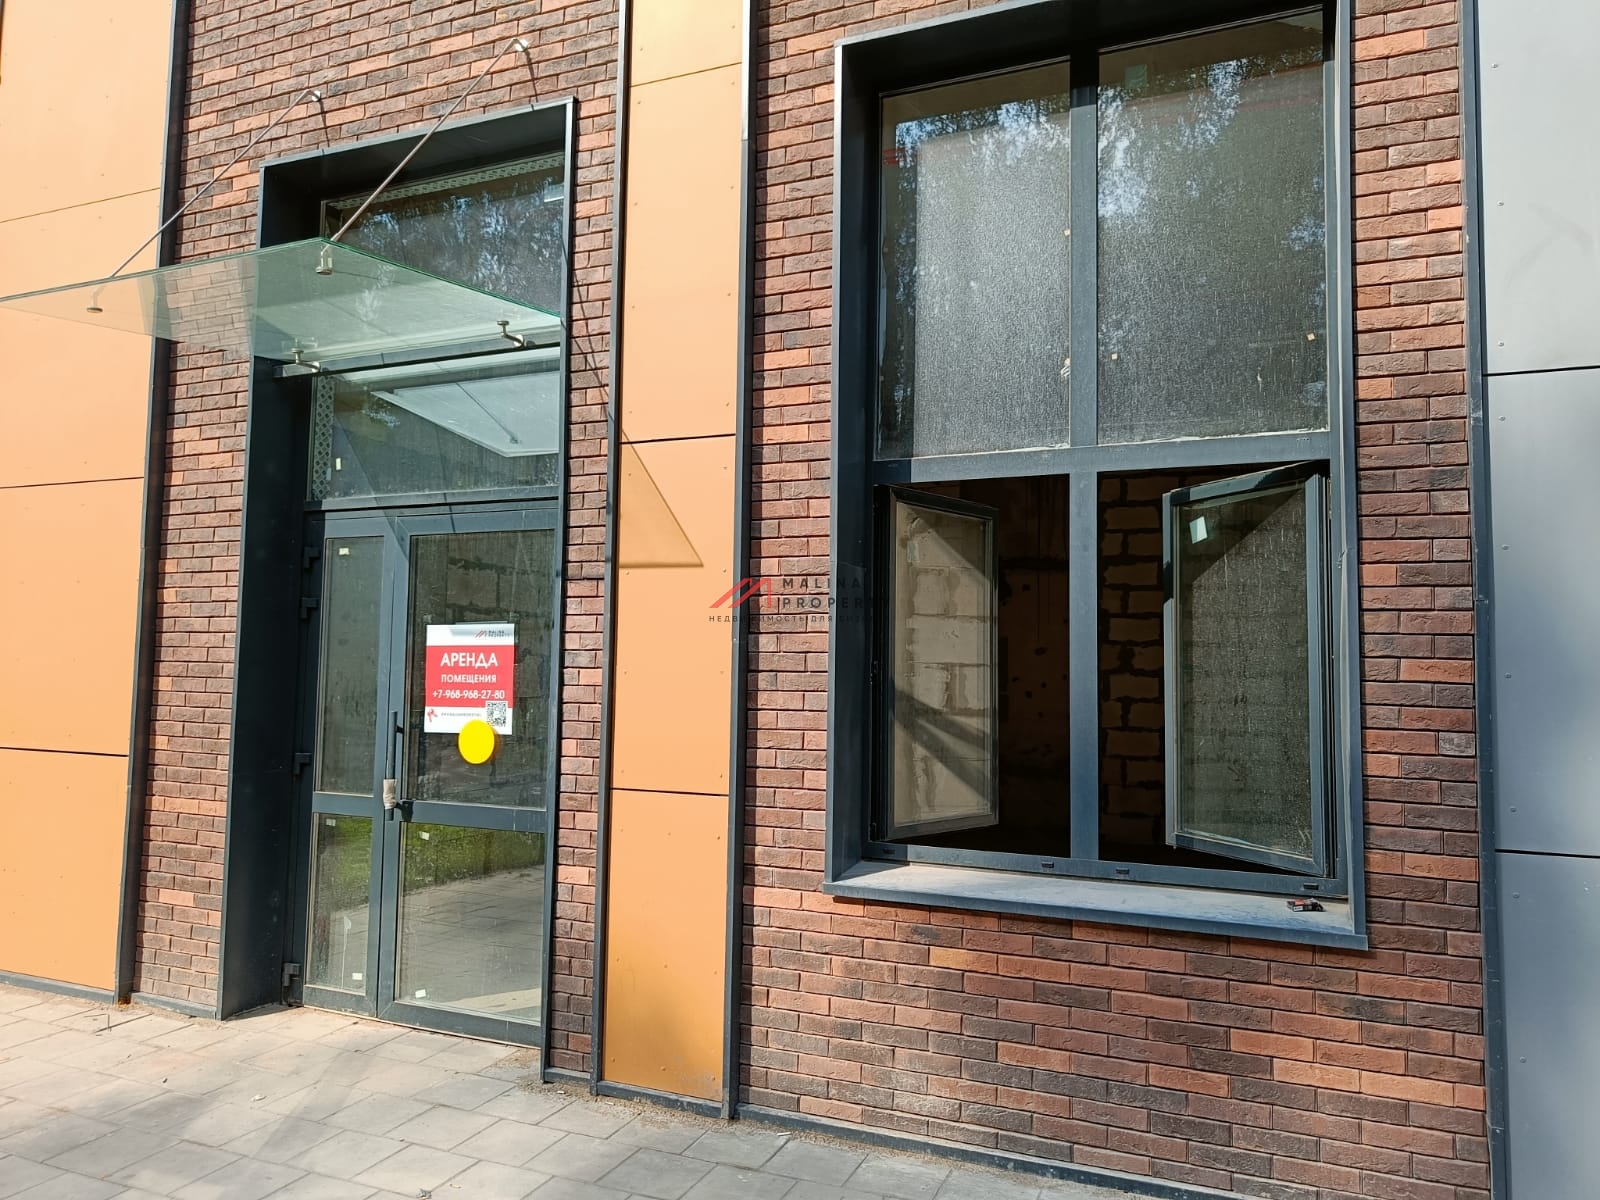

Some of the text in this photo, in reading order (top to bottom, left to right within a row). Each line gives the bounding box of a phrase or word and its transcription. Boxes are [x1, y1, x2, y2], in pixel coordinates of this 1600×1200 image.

[440, 652, 499, 669] АРЕНДА
[441, 674, 497, 684] ПОМЕЩЕНИЯ
[432, 689, 505, 699] +7-968-968-27-80
